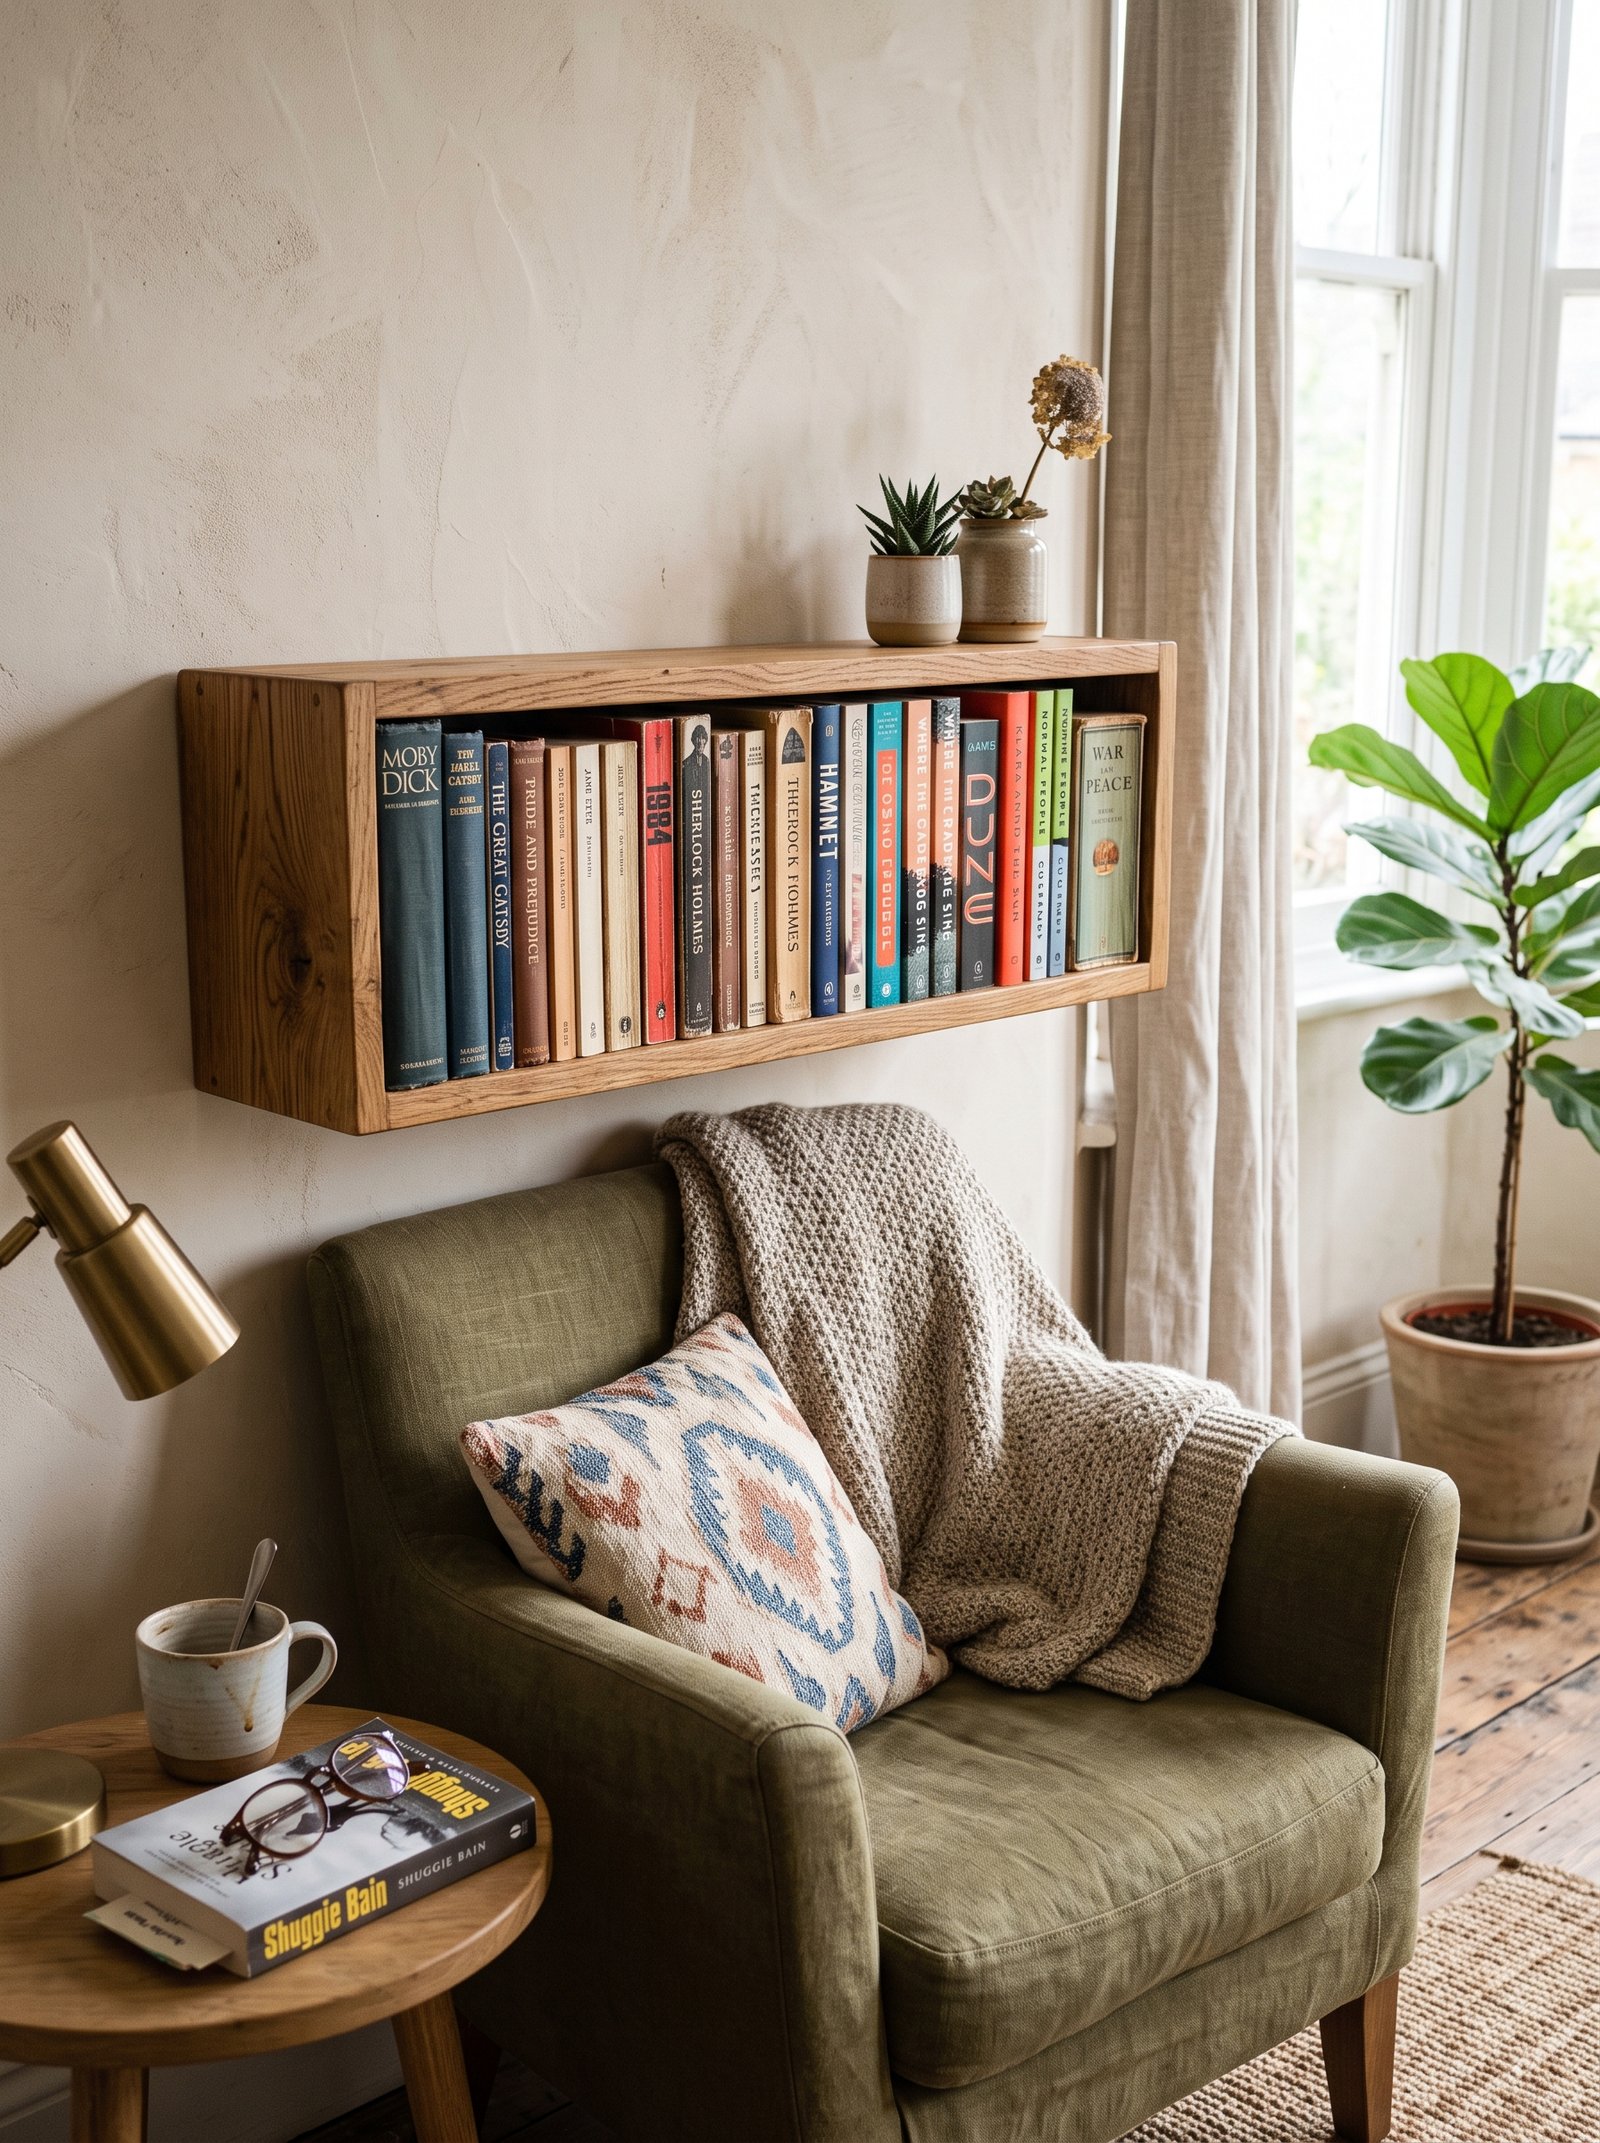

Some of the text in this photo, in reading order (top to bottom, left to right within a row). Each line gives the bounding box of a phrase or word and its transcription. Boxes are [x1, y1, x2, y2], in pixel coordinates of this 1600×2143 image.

[382, 745, 438, 769] MOBY
[917, 716, 928, 775] WHERE
[943, 713, 954, 770] WHERE
[1015, 725, 1023, 783] KLARA
[1092, 745, 1124, 761] WAR
[382, 767, 440, 796] DICK
[492, 781, 505, 816] THE
[917, 782, 927, 812] THE
[1039, 780, 1047, 835] PEOPLE
[1086, 776, 1132, 794] PEACE
[646, 782, 672, 846] 1984
[819, 763, 838, 860] HAMNET
[493, 822, 507, 878] GREAT
[525, 777, 539, 965] PRIDE AND PREJUDICE
[692, 789, 704, 955] SHERLOCK HOLMES
[964, 773, 996, 925] DUNE
[916, 918, 926, 955] SINS
[398, 1840, 487, 1890] SHUGGIE BAIN
[263, 1898, 342, 1960] Shuggie
[346, 1876, 388, 1923] Bain
